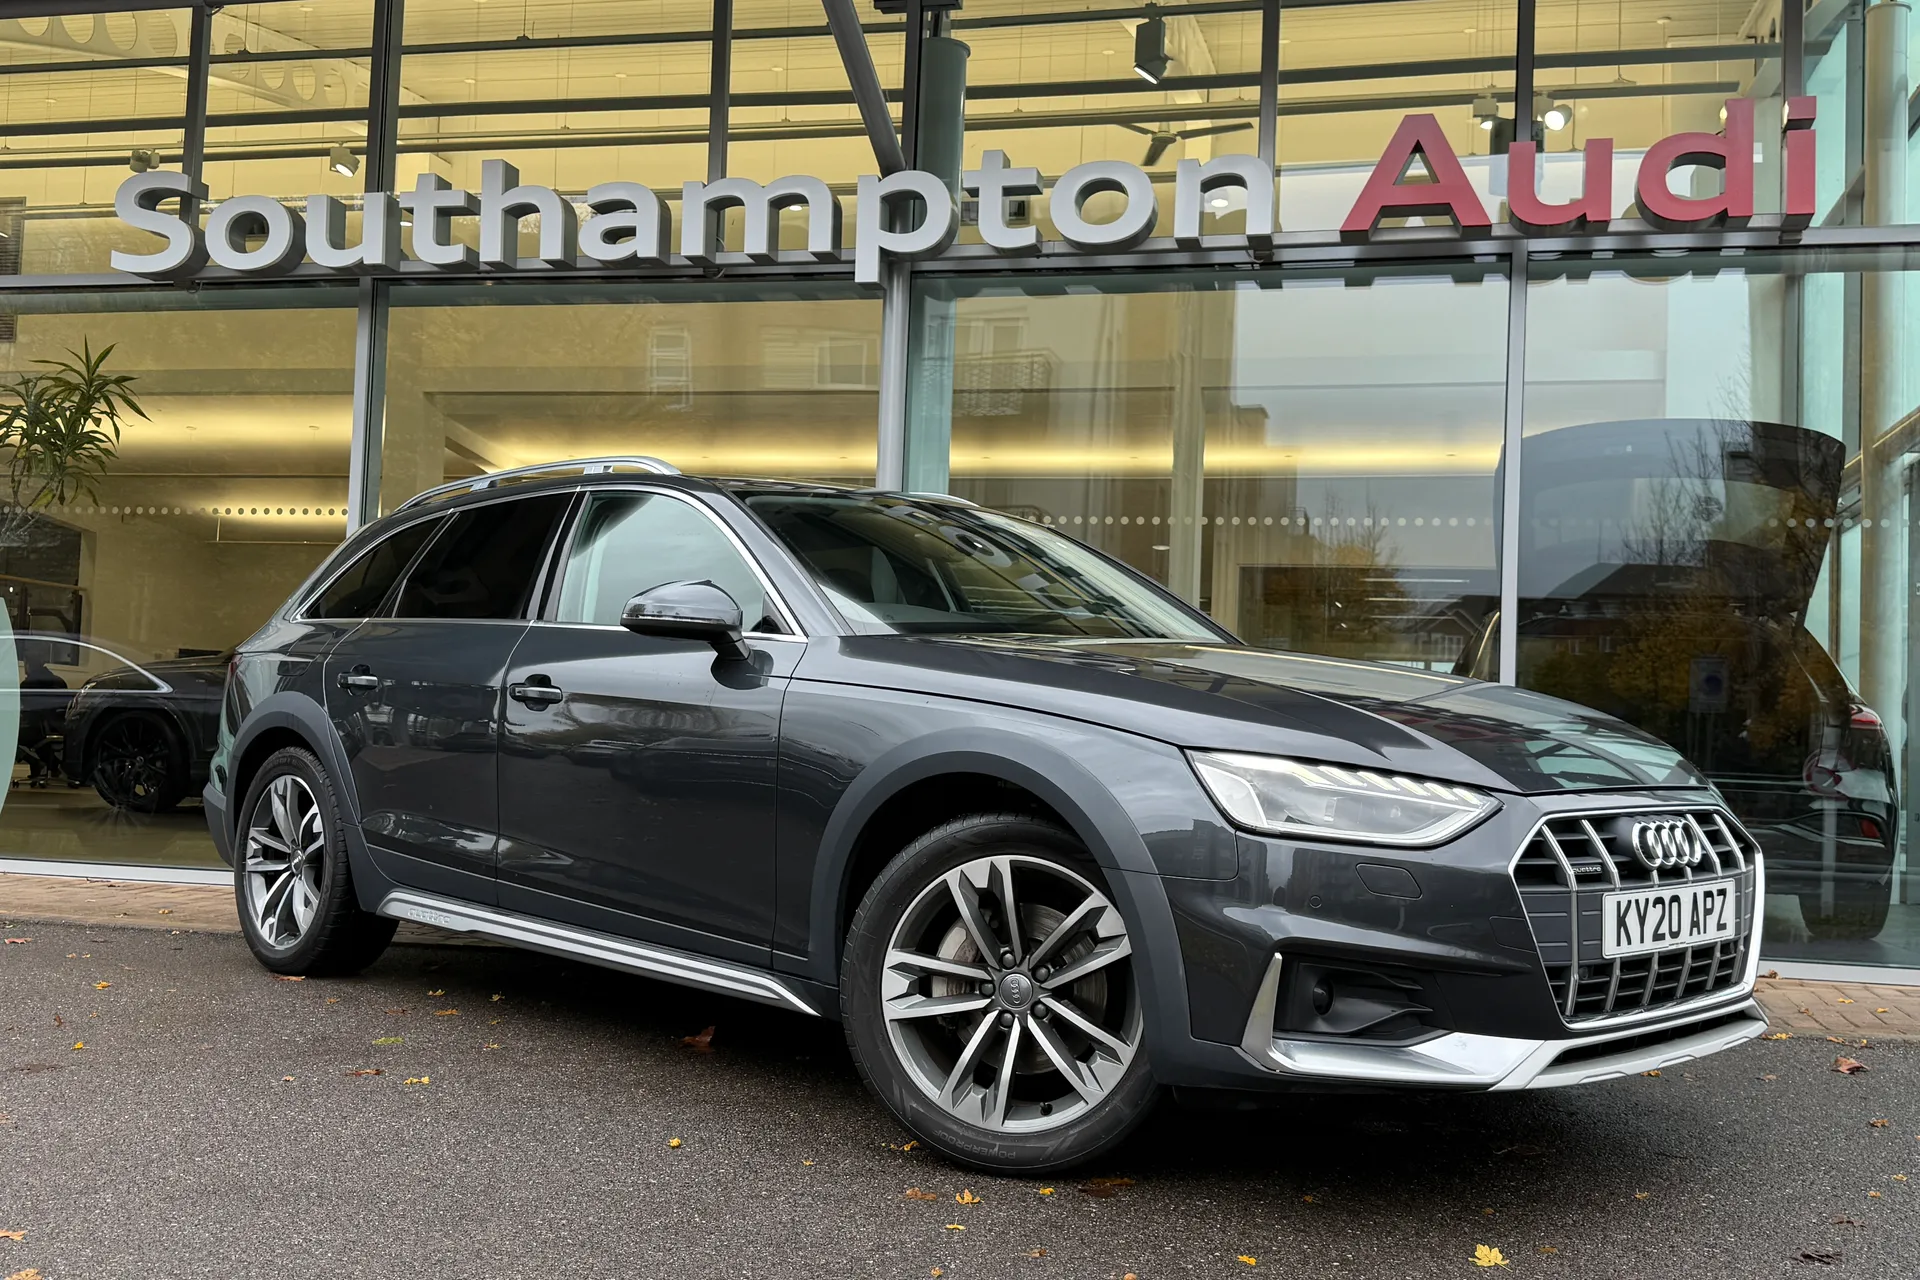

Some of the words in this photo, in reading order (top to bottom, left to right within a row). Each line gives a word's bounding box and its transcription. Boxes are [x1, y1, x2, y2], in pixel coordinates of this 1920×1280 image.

[111, 149, 1276, 284] Southampton
[1340, 96, 1816, 232] Audi
[1616, 895, 1681, 947] KY20
[1689, 888, 1727, 936] APZ
[933, 1129, 1016, 1159] POWERPROOF
